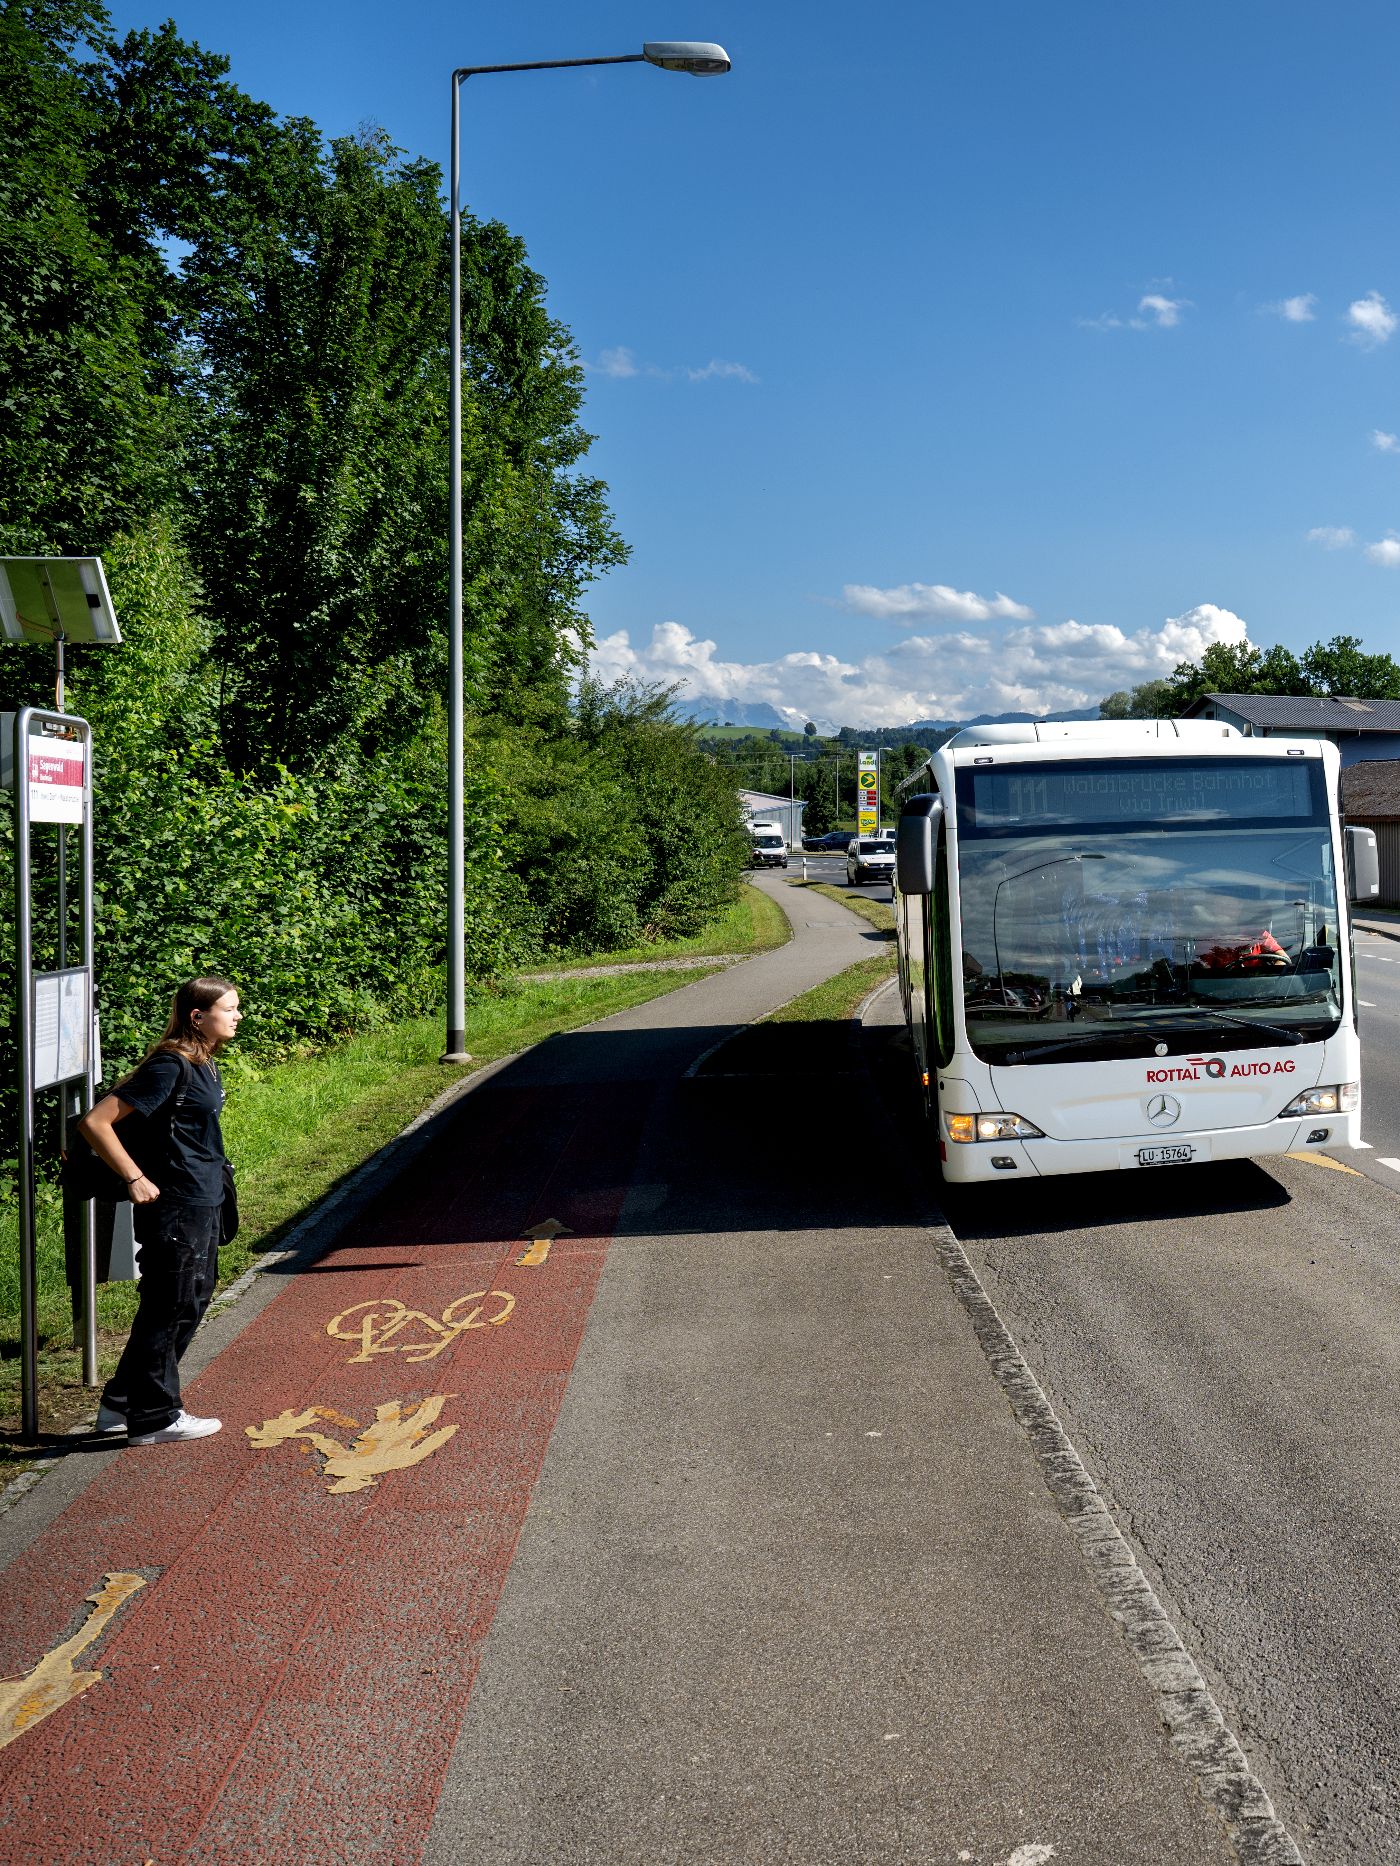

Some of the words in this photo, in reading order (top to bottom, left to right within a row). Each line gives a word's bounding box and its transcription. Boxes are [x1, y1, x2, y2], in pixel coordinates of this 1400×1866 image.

[1008, 778, 1048, 815] 111
[1063, 773, 1186, 796] Waldibrücke
[1192, 769, 1273, 791] Bahnhof
[1119, 795, 1151, 814] via
[1157, 791, 1206, 812] Inwil
[1146, 1067, 1200, 1083] ROTTAL
[1230, 1061, 1271, 1077] AUTO
[1273, 1060, 1296, 1074] AG
